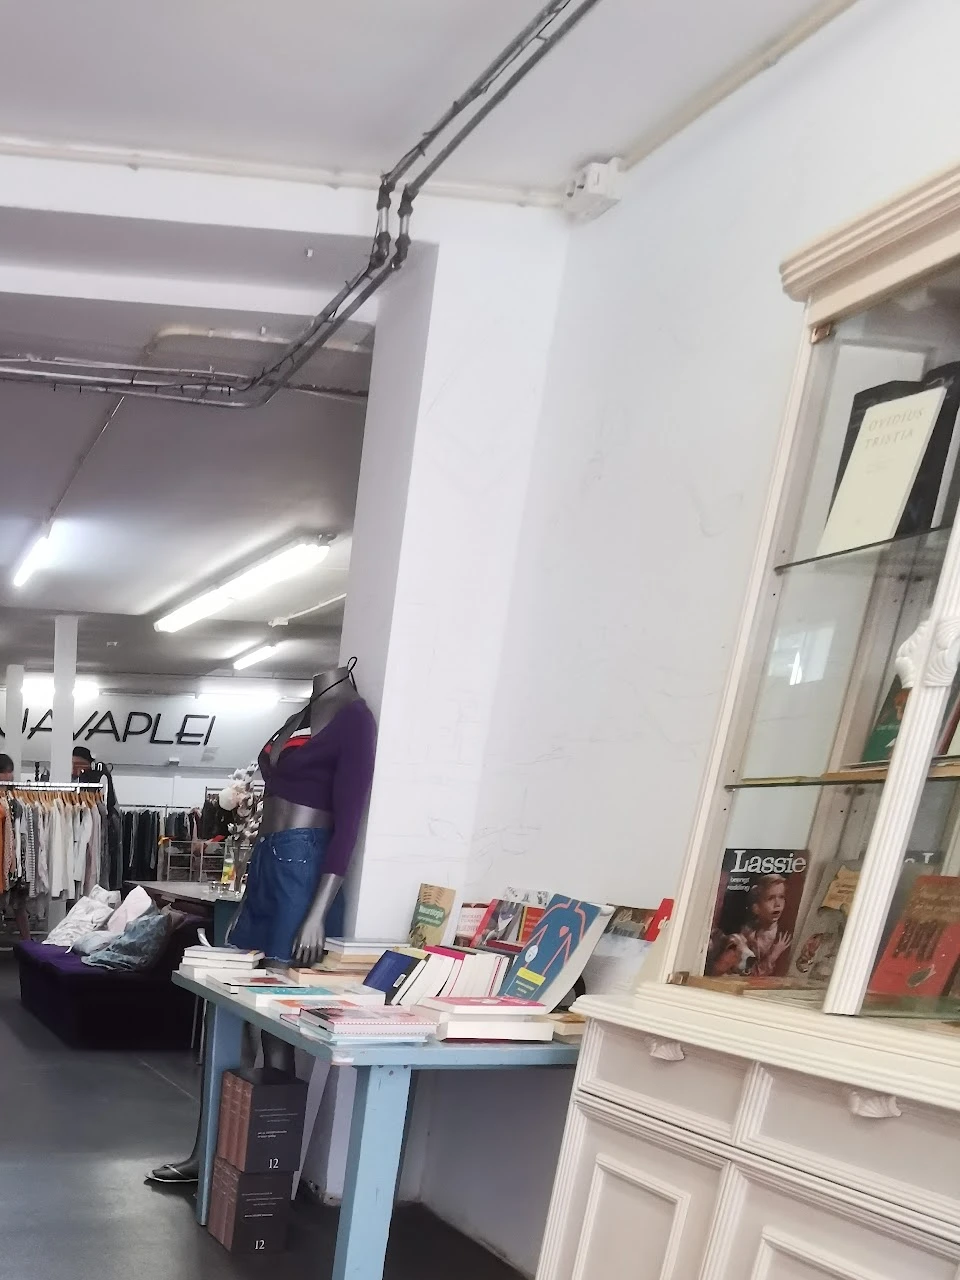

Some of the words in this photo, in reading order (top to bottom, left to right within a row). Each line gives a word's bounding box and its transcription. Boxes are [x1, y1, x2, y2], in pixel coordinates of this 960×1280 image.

[868, 407, 925, 432] OVIDIUS
[864, 428, 915, 449] TRISTIA
[730, 849, 807, 874] Lassie
[268, 1158, 279, 1169] 12
[254, 1239, 265, 1250] 12
